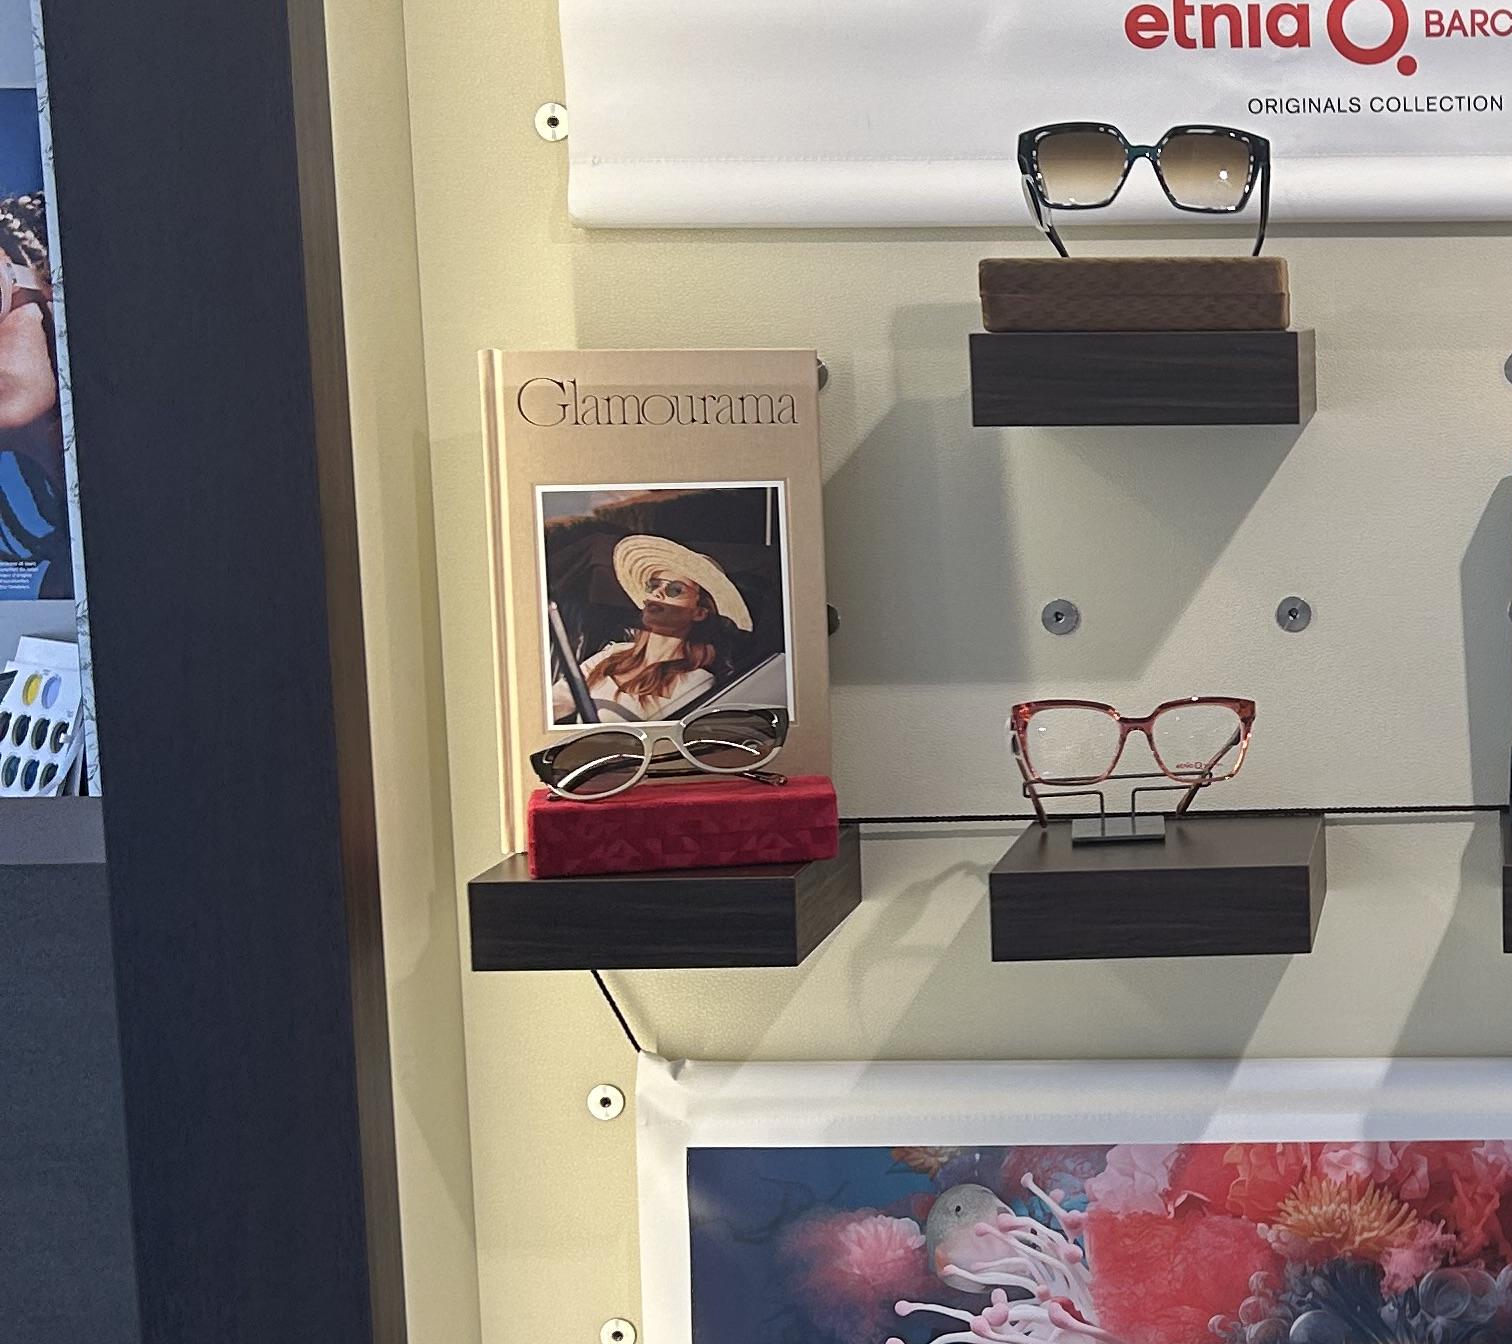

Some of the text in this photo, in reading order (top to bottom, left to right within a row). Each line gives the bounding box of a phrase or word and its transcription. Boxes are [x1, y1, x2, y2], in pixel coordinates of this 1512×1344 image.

[1247, 95, 1504, 115] ORIGINALS COLLECTION
[517, 377, 799, 427] Glamourama
